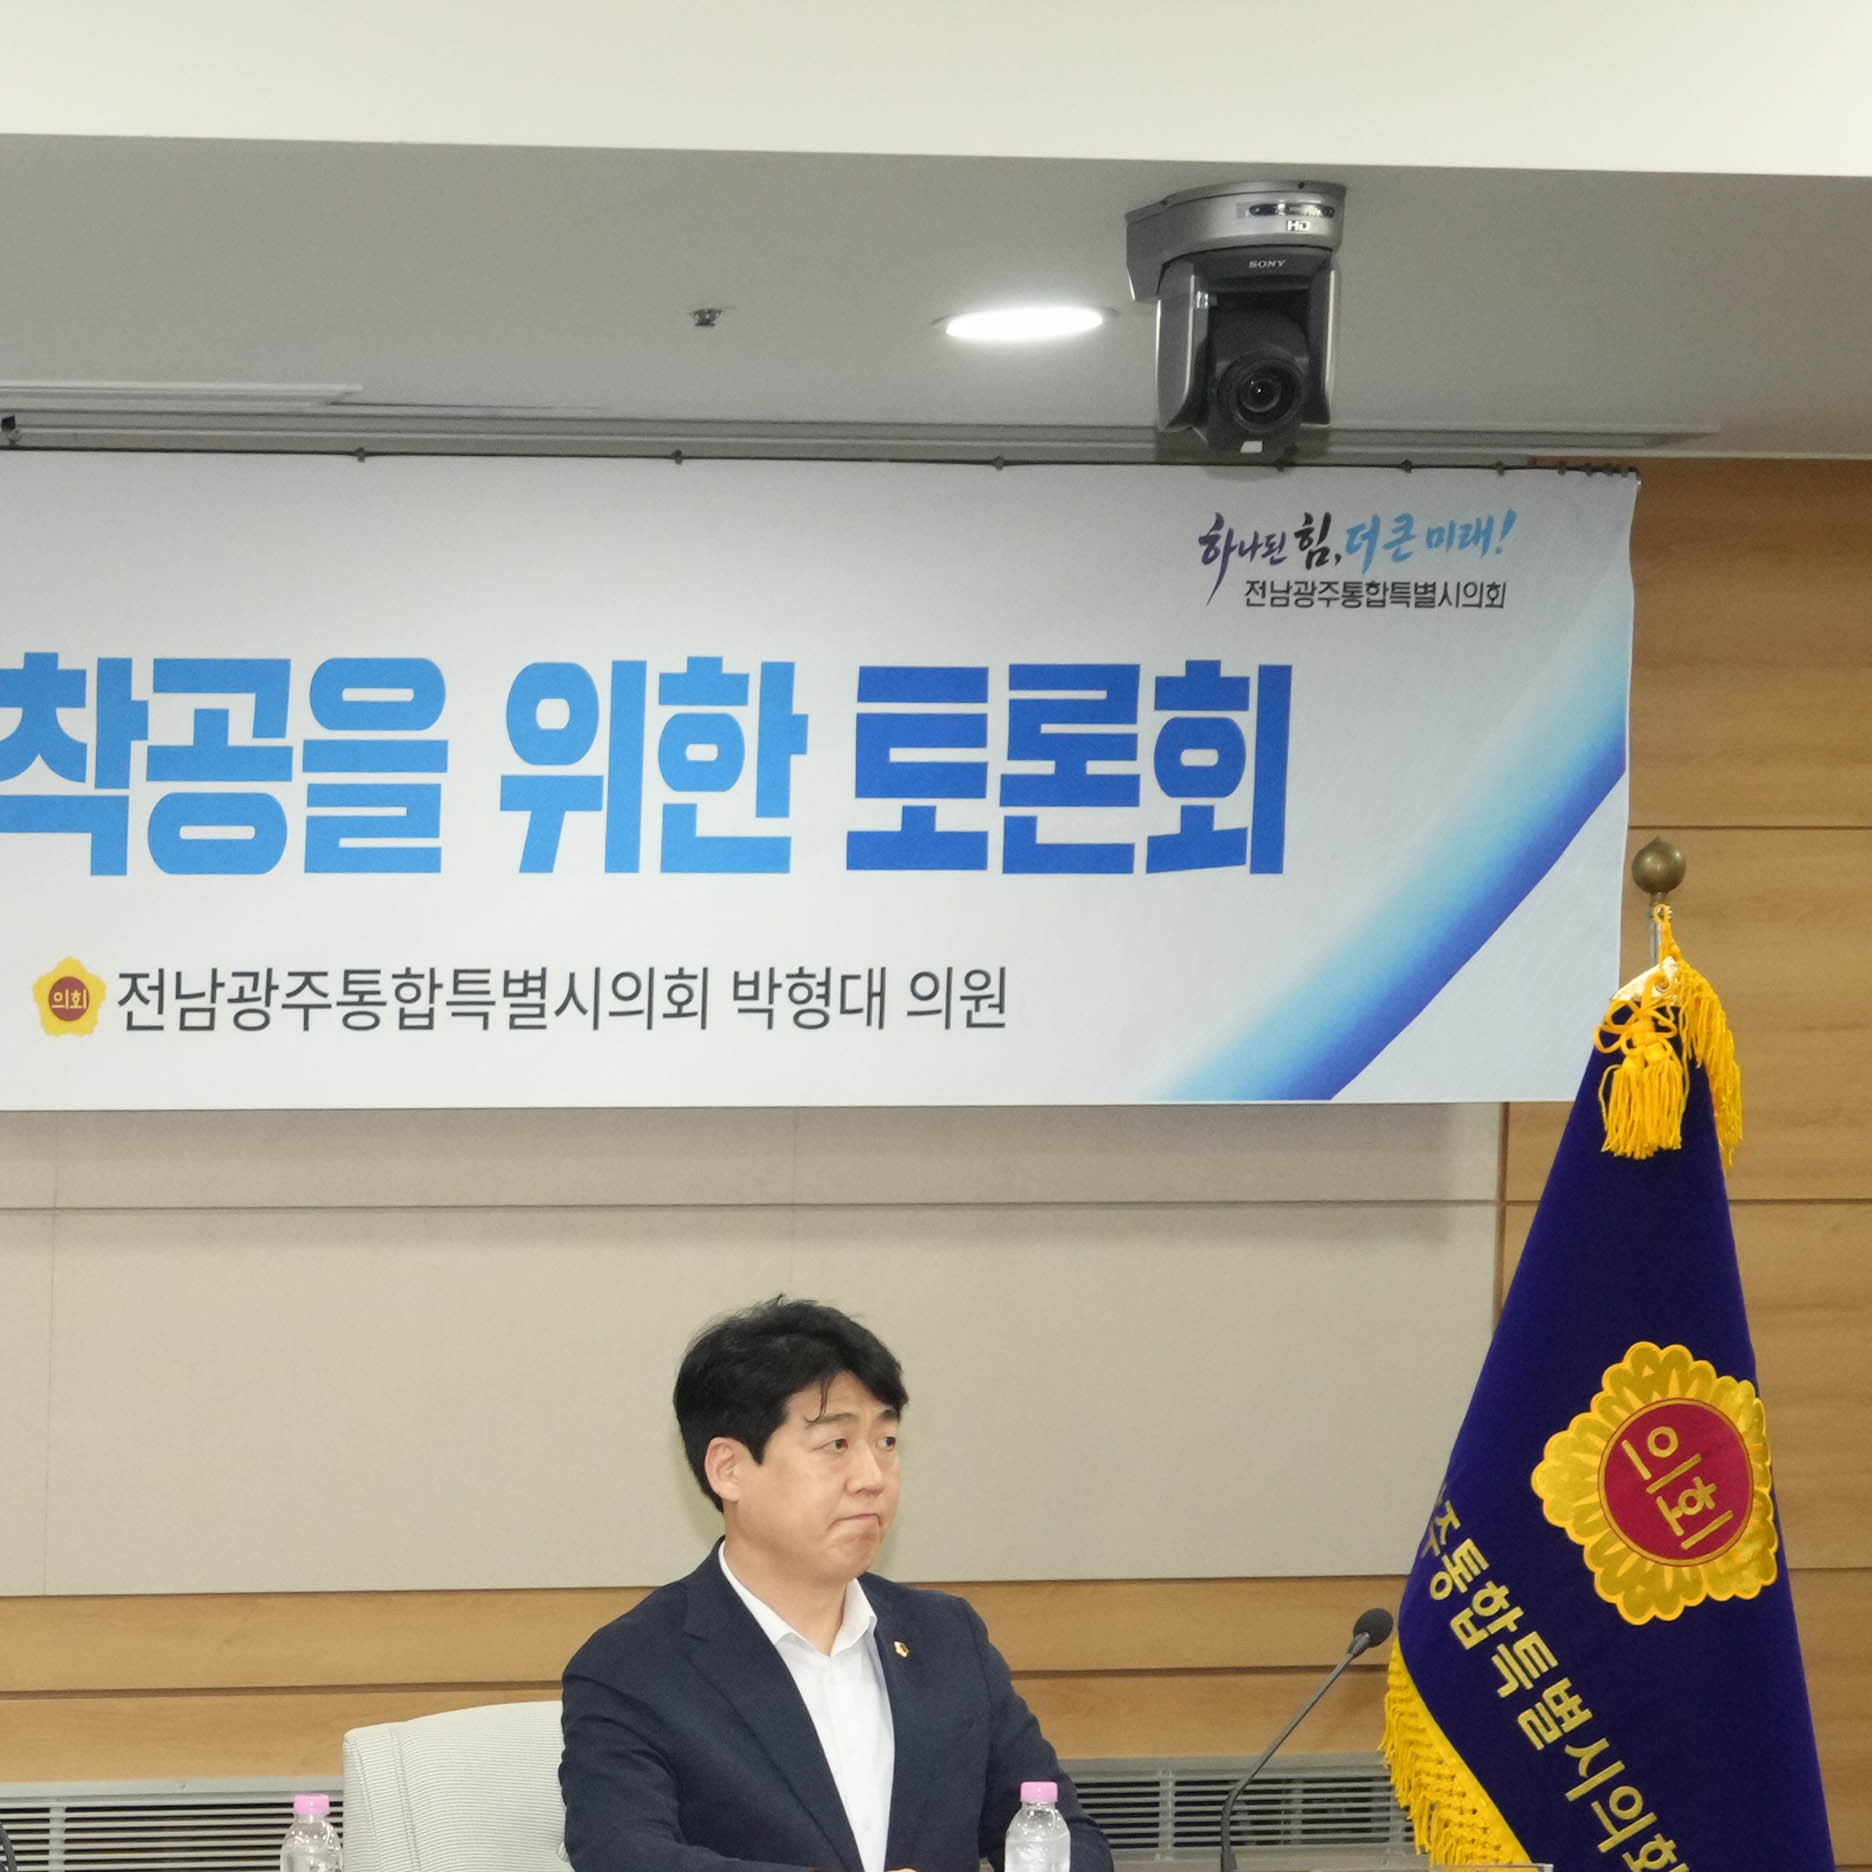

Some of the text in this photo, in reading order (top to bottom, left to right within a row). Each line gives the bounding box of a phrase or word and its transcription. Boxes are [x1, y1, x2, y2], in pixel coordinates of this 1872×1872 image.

[1287, 220, 1311, 231] HD
[1248, 259, 1286, 269] SONY
[1199, 511, 1288, 607] 하나된
[1346, 514, 1381, 574] 더
[1382, 512, 1417, 563] 큰
[1426, 509, 1517, 558] 미래!
[1245, 580, 1507, 609] 전남광주통합특별시의회
[500, 656, 810, 876] 위한
[843, 655, 1294, 878] 토론회
[51, 988, 88, 1010] 의회
[117, 966, 1008, 1033] 전남광주통합특별시의회 박형대 의원
[1620, 1425, 1734, 1550] 의회
